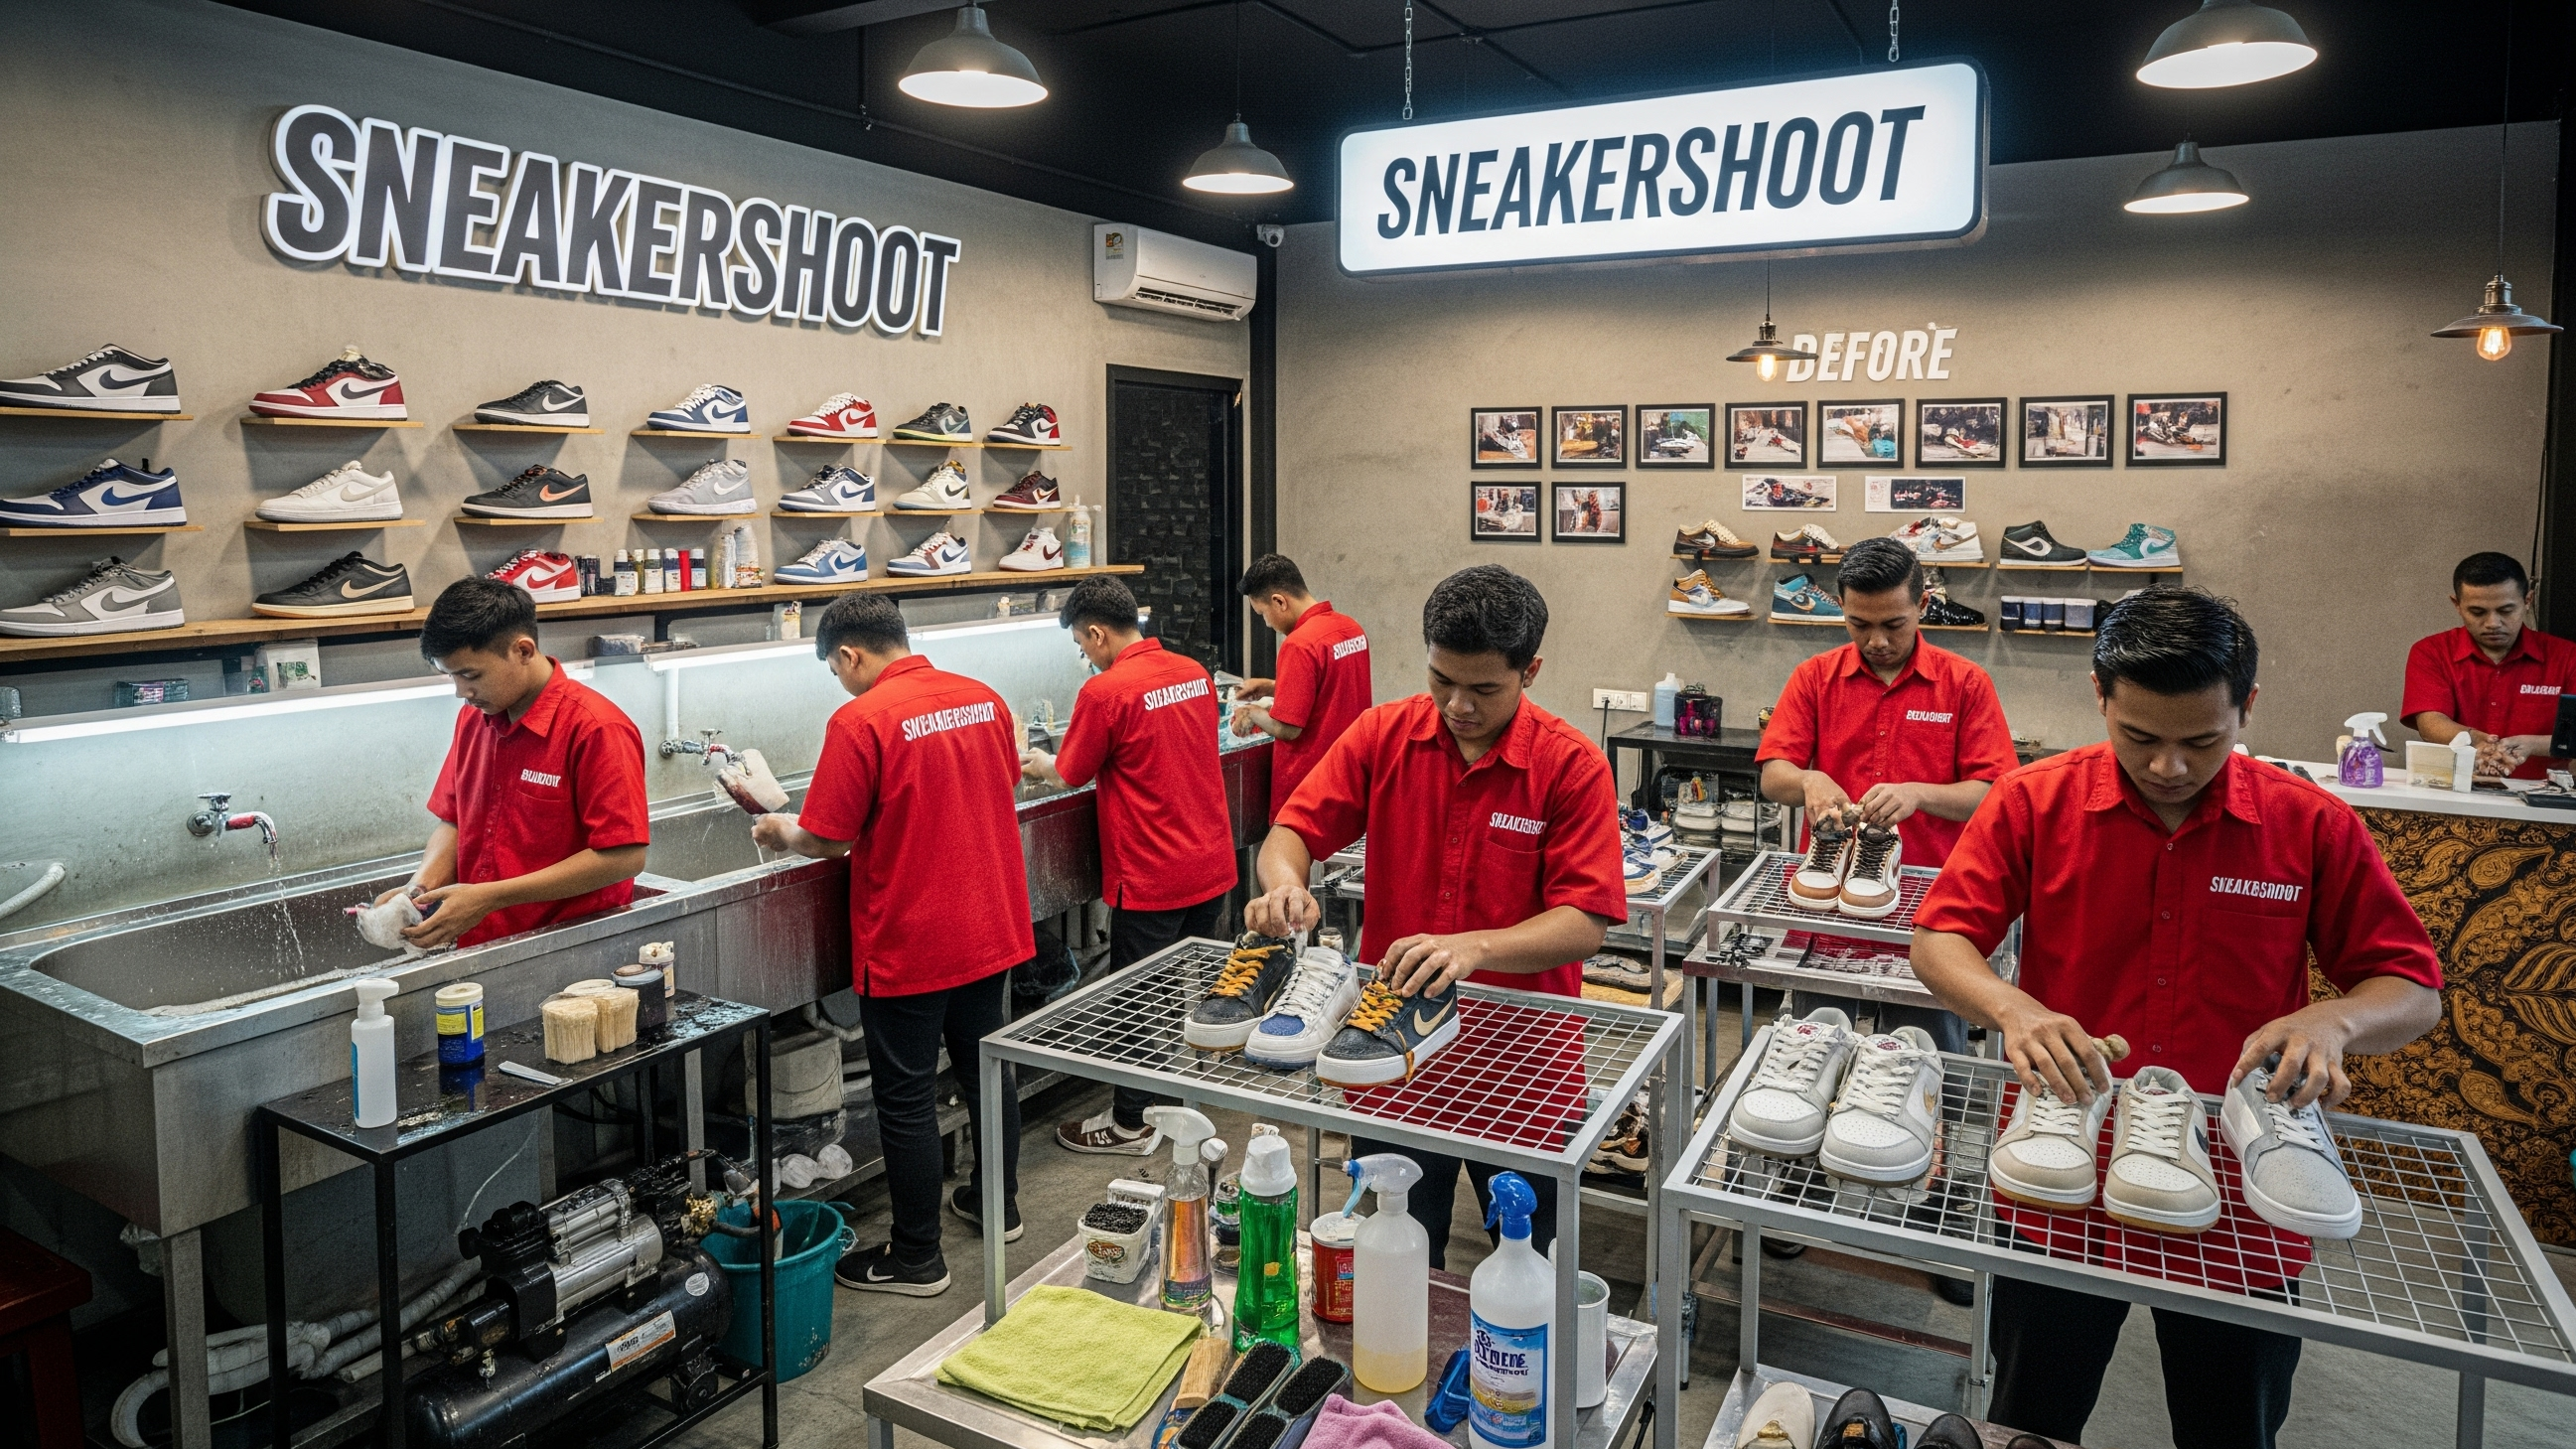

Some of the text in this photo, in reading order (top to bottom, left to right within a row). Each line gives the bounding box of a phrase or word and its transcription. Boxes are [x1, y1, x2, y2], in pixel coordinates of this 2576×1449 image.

[262, 104, 961, 337] SNEAKERSHOOT
[1377, 105, 1926, 239] SNEAKERSHOOT
[1787, 329, 1958, 382] BEFORE
